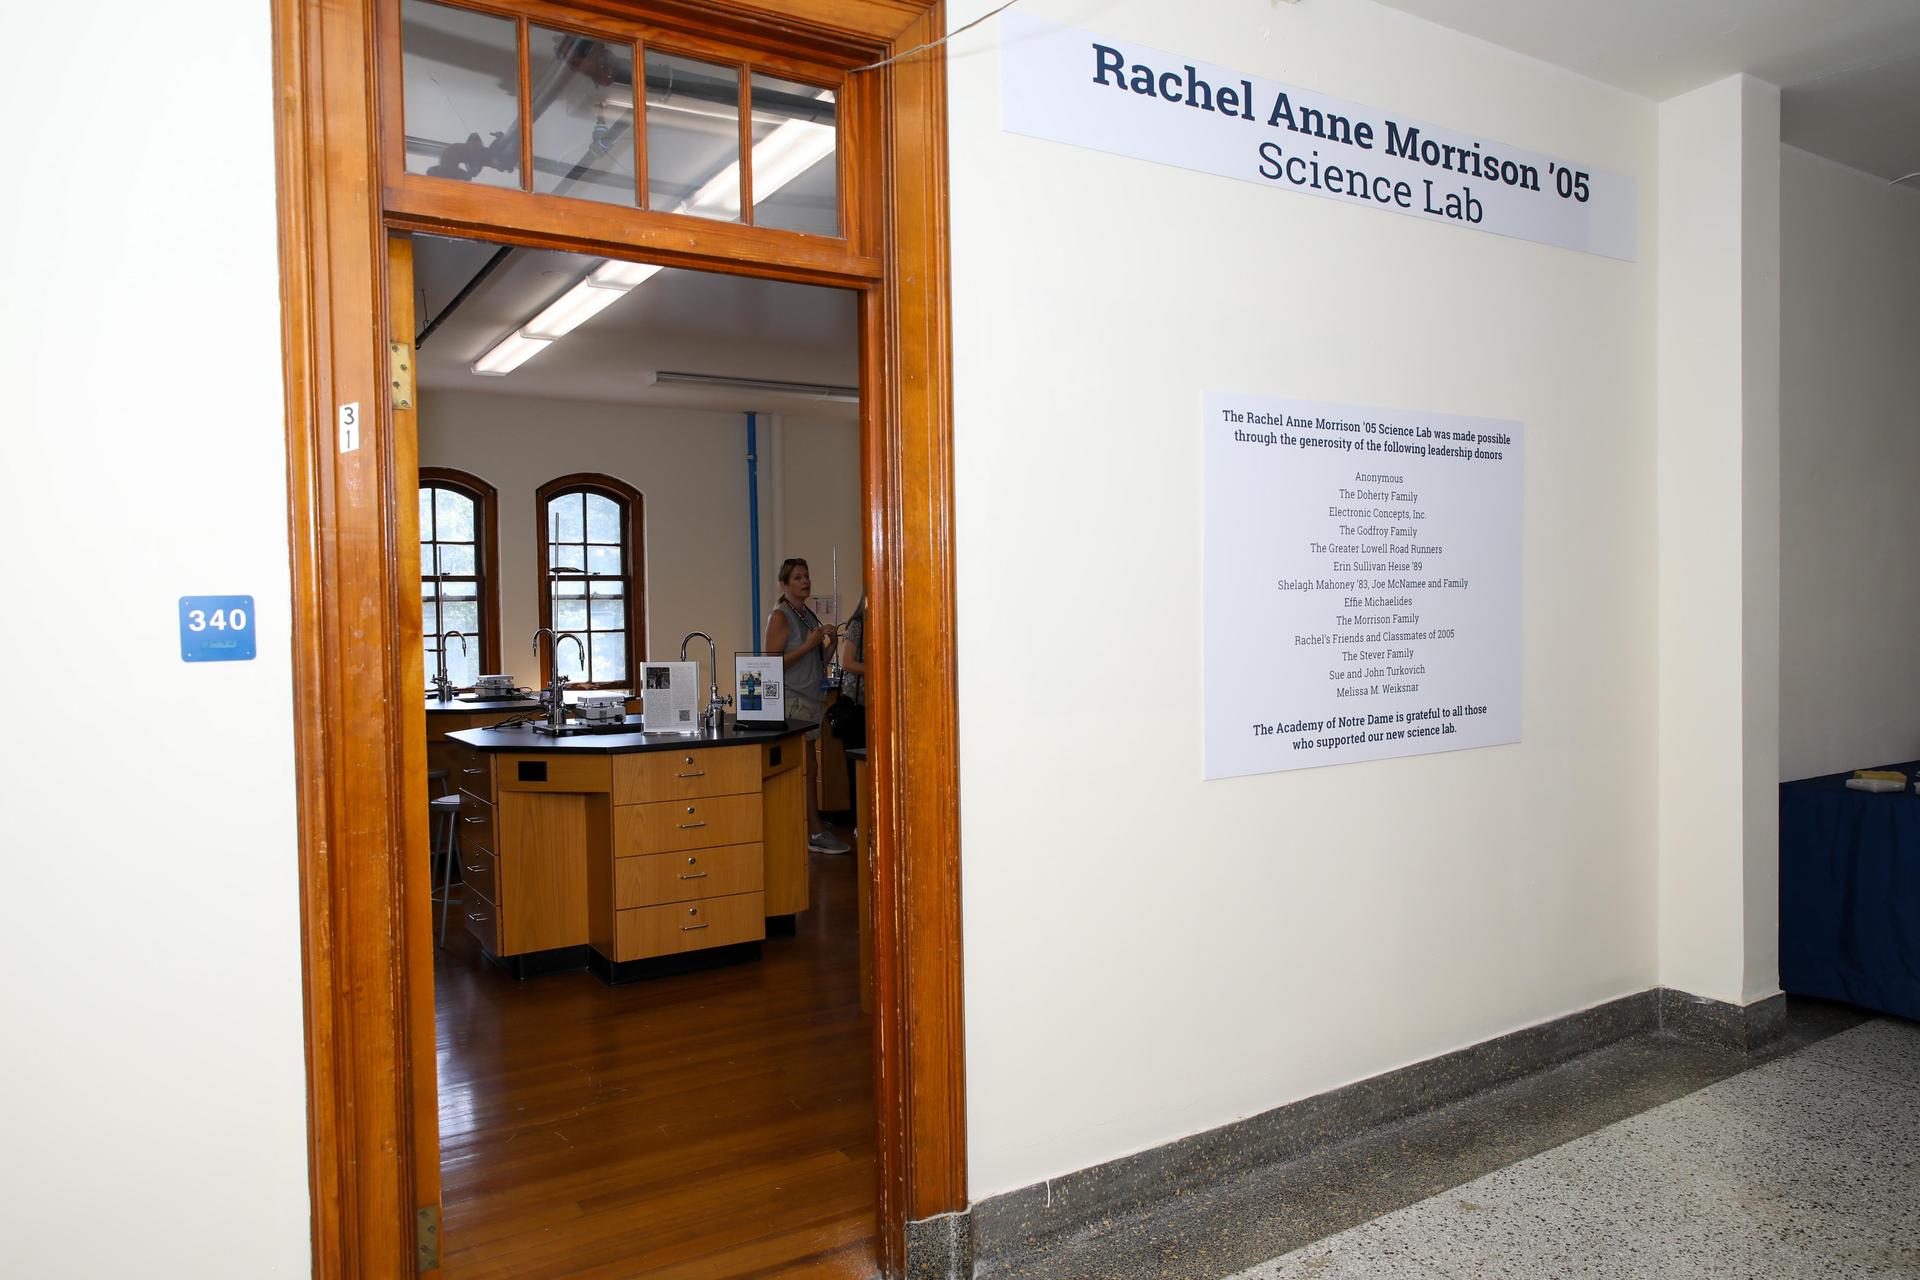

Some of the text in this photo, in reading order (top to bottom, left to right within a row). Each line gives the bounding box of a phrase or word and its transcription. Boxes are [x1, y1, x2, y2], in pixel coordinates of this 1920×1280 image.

[1092, 43, 1256, 122] Rachel
[1267, 92, 1374, 150] Anne
[1384, 120, 1541, 192] Morrison
[1258, 141, 1483, 224] Science Lab
[1222, 409, 1244, 423] The
[1246, 411, 1284, 427] Rachel
[1285, 415, 1313, 429] Anne
[1315, 417, 1361, 433] Morrison
[1378, 423, 1414, 437] Science
[1415, 426, 1432, 439] Lab
[1433, 430, 1451, 440] was
[1452, 430, 1476, 442] made
[1477, 433, 1511, 445] possible
[1234, 428, 1503, 461] through the generosity of the following leadership donors
[1354, 471, 1404, 485] Anonymous
[1338, 488, 1418, 504] The Doherty Family
[1329, 505, 1427, 521] Electronic Concepts, Inc.
[1339, 524, 1418, 539] The Godfroy Family
[1310, 542, 1443, 554] The Greater Lowell Road Runners
[1333, 561, 1352, 572] Erin
[1353, 560, 1387, 572] Sullivan
[1387, 561, 1411, 572] Heise
[1277, 579, 1314, 593] Shelagh
[1315, 578, 1355, 592] Mahoney
[1371, 578, 1386, 590] Joe
[1387, 578, 1427, 589] McNamee
[1427, 578, 1442, 589] and
[1443, 577, 1469, 590] Family
[1344, 595, 1413, 608] Effie Michaelides
[188, 608, 247, 632] 340
[1335, 612, 1420, 626] The Morrison Family
[1332, 632, 1365, 644] Friends
[1365, 631, 1382, 643] and
[1382, 631, 1427, 642] Classmates
[1428, 629, 1437, 640] of
[1437, 628, 1455, 639] 2005
[1341, 647, 1414, 662] The Stever Family
[1328, 664, 1426, 681] Sue and John Turkovich
[1336, 682, 1419, 698] Melissa M. Weiksnar
[1252, 704, 1487, 736] The Academy of Notre Dame is grateful to all those
[1292, 722, 1456, 750] who supported our new science lab.
